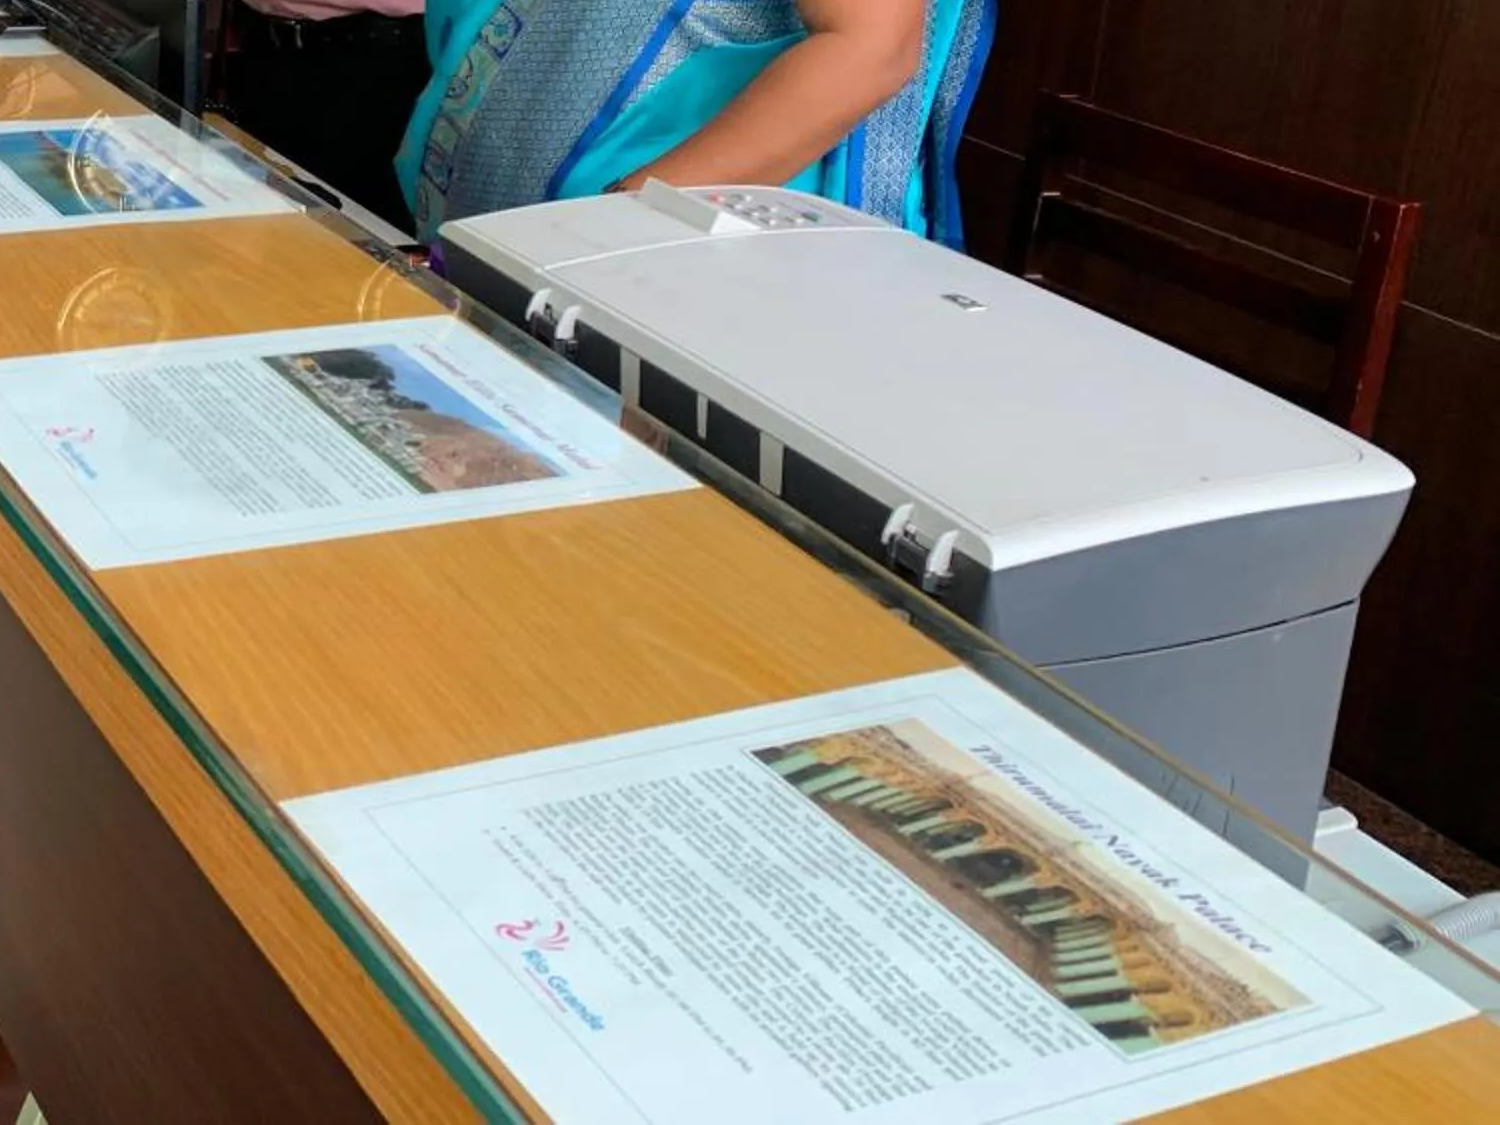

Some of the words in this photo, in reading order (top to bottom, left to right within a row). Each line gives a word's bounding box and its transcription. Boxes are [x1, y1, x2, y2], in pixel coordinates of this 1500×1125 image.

[970, 744, 1102, 833] Thirumalai
[1095, 834, 1181, 889] Nayak
[1177, 892, 1273, 955] Palace
[547, 975, 606, 1030] Grande
